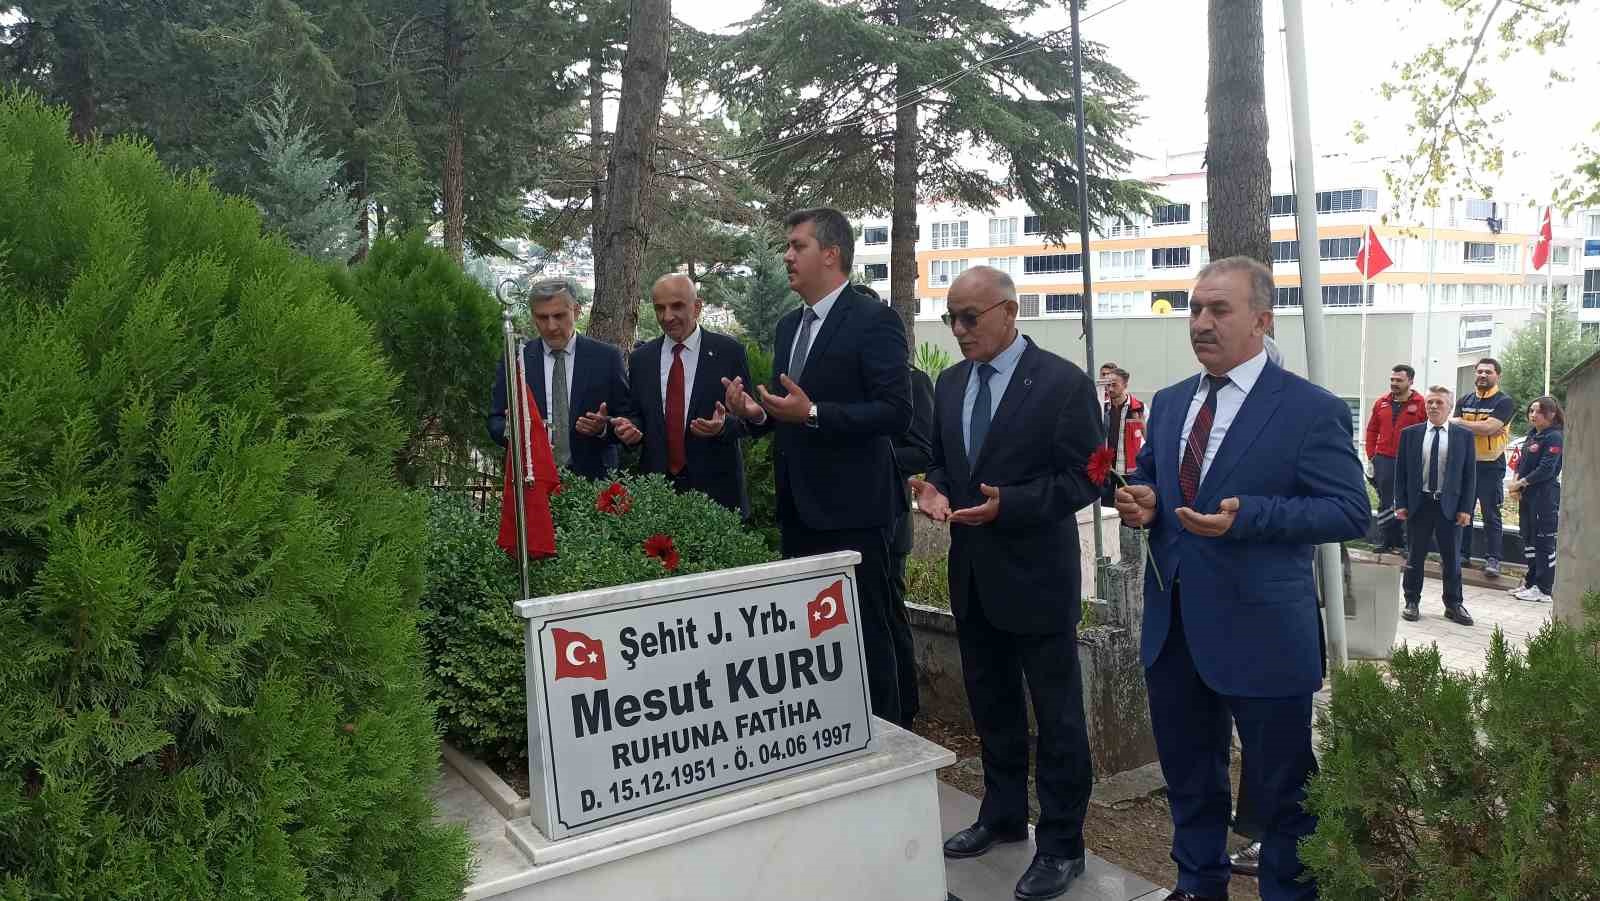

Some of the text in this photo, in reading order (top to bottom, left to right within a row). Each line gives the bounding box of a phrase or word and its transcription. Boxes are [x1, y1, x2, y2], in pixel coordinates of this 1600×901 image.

[619, 601, 796, 670] Şehit J. Yrb.
[571, 641, 845, 738] Mesut KURU
[581, 789, 603, 813] D.
[608, 756, 717, 805] 15.12.1951
[734, 748, 754, 771] Ö.
[759, 734, 807, 765] 04.06
[812, 722, 853, 751] 1997
[611, 699, 822, 770] RUHUNA FATİHA
